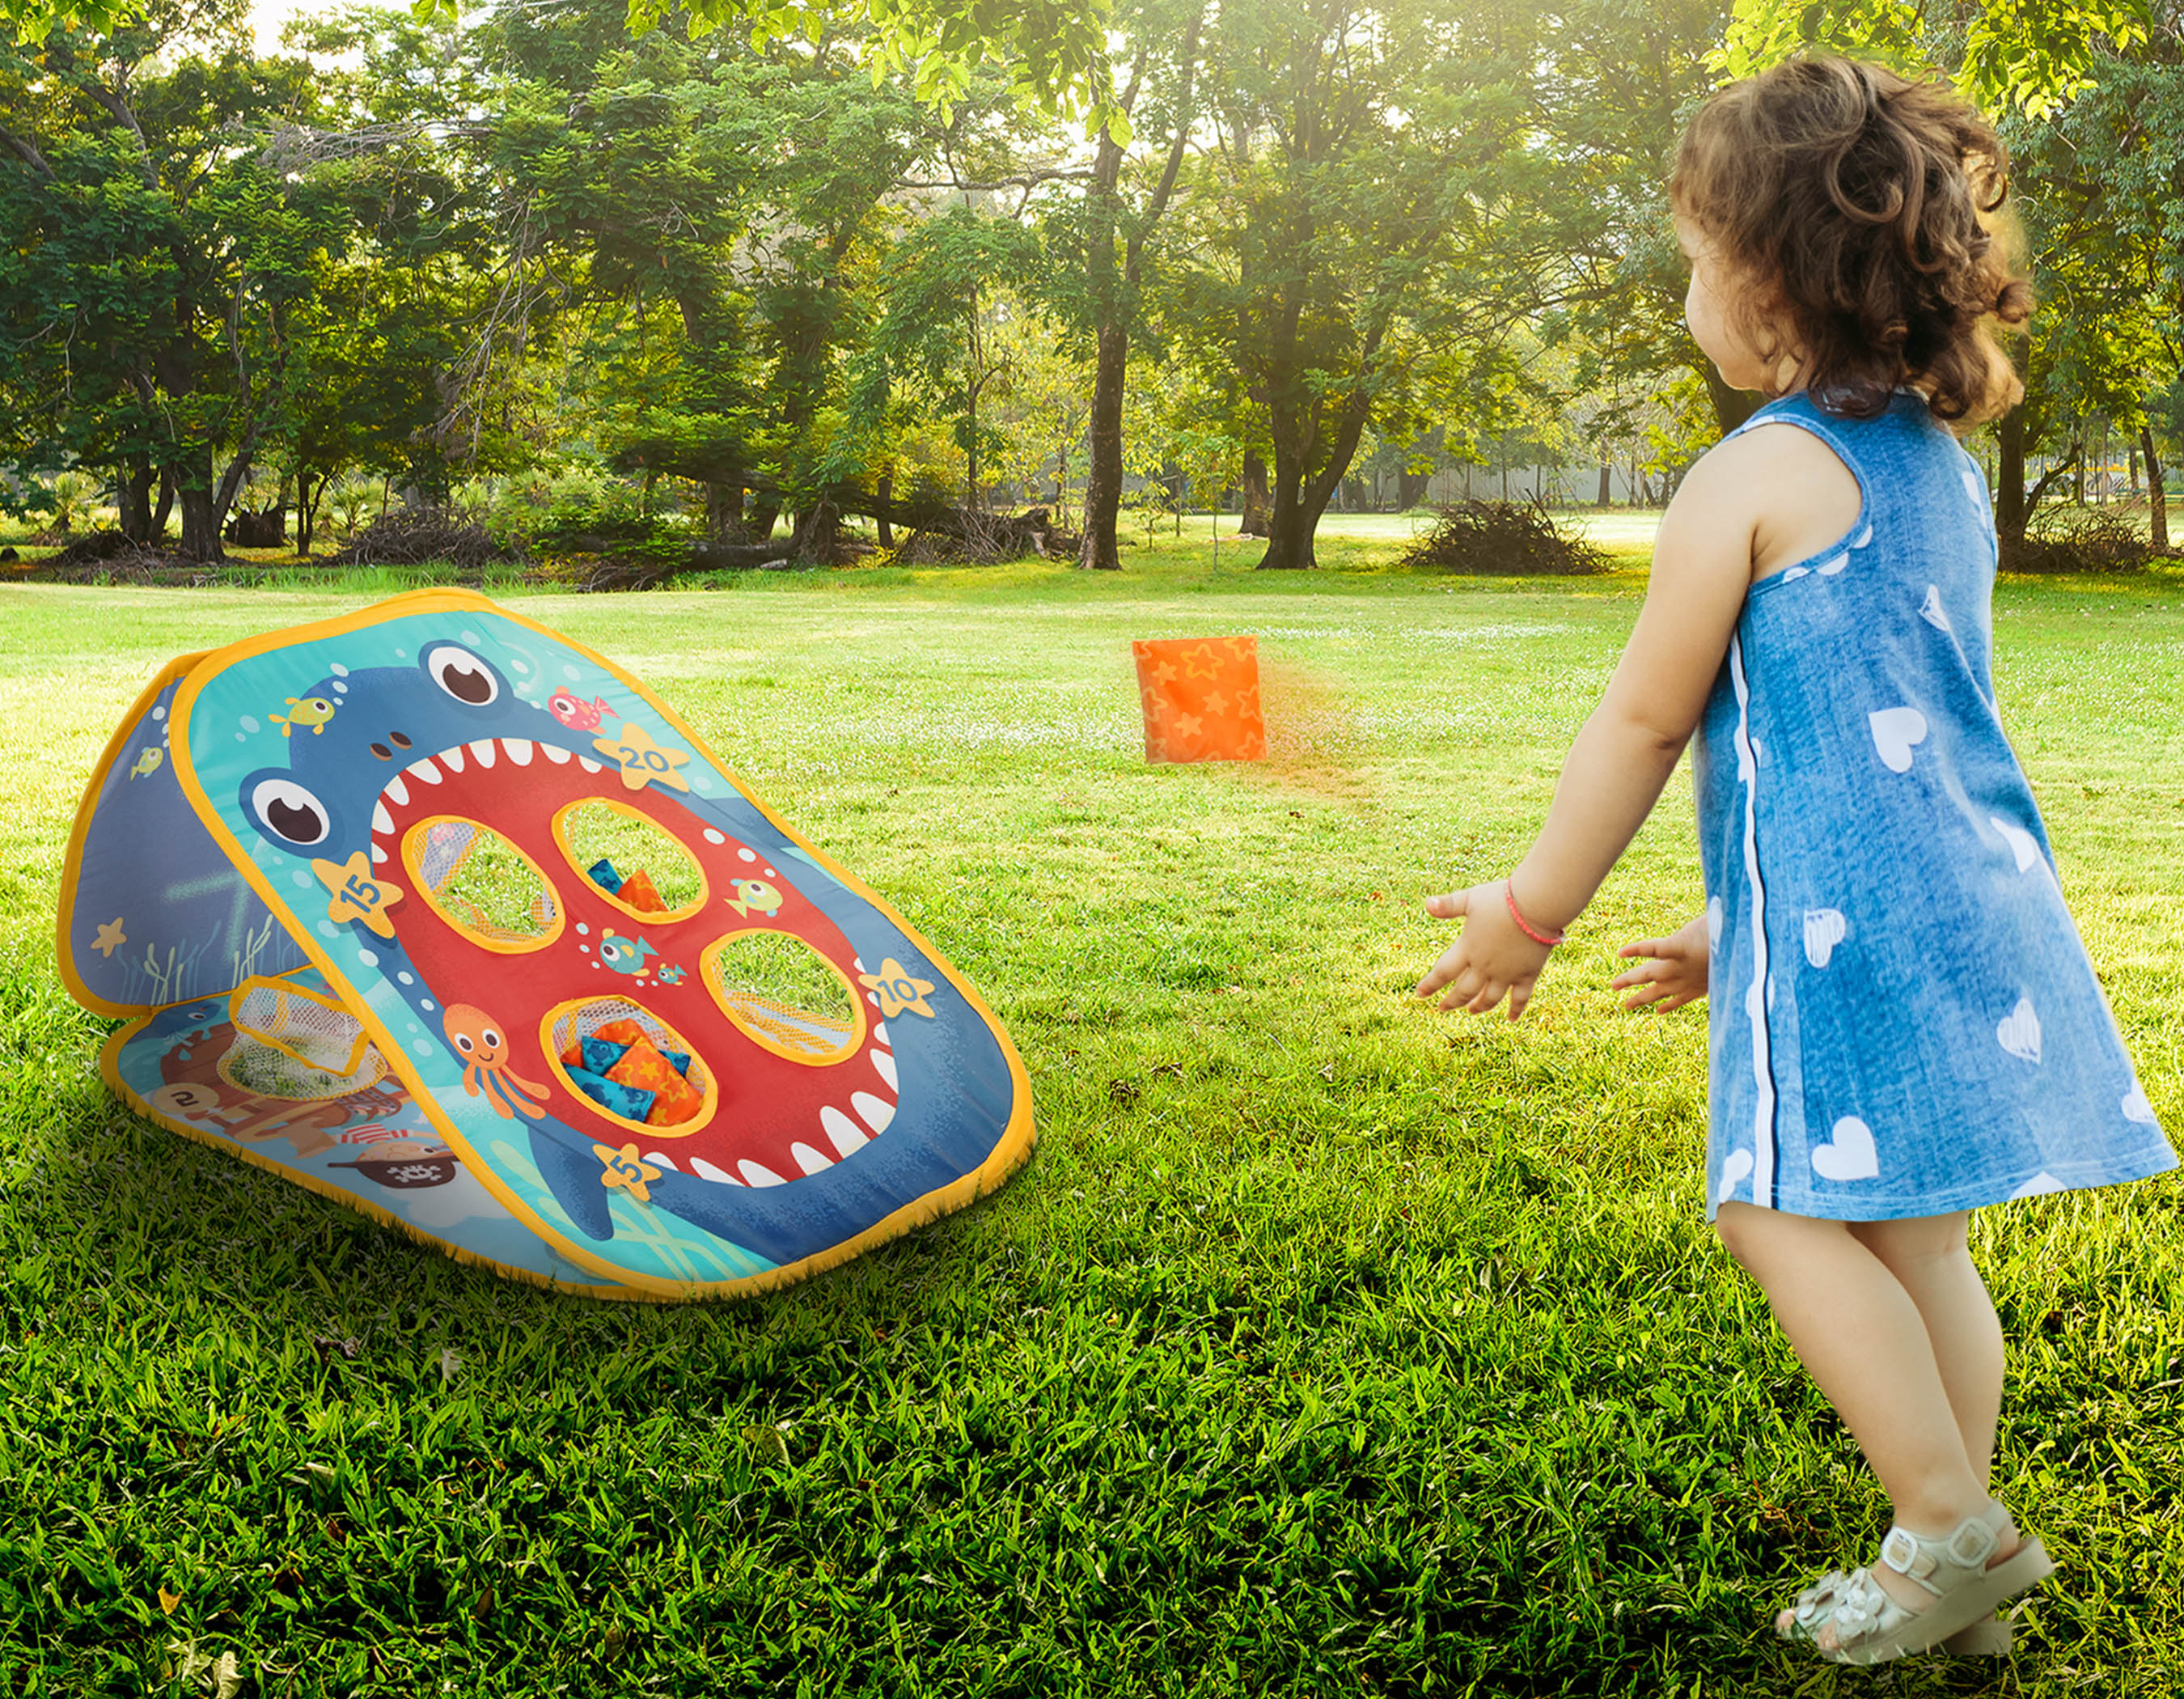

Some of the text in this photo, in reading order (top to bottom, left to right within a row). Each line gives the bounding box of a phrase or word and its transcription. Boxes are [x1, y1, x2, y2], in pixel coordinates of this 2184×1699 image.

[618, 746, 669, 773] 20
[340, 874, 380, 913] 15
[875, 978, 918, 1002] 10
[609, 1155, 642, 1184] 5
